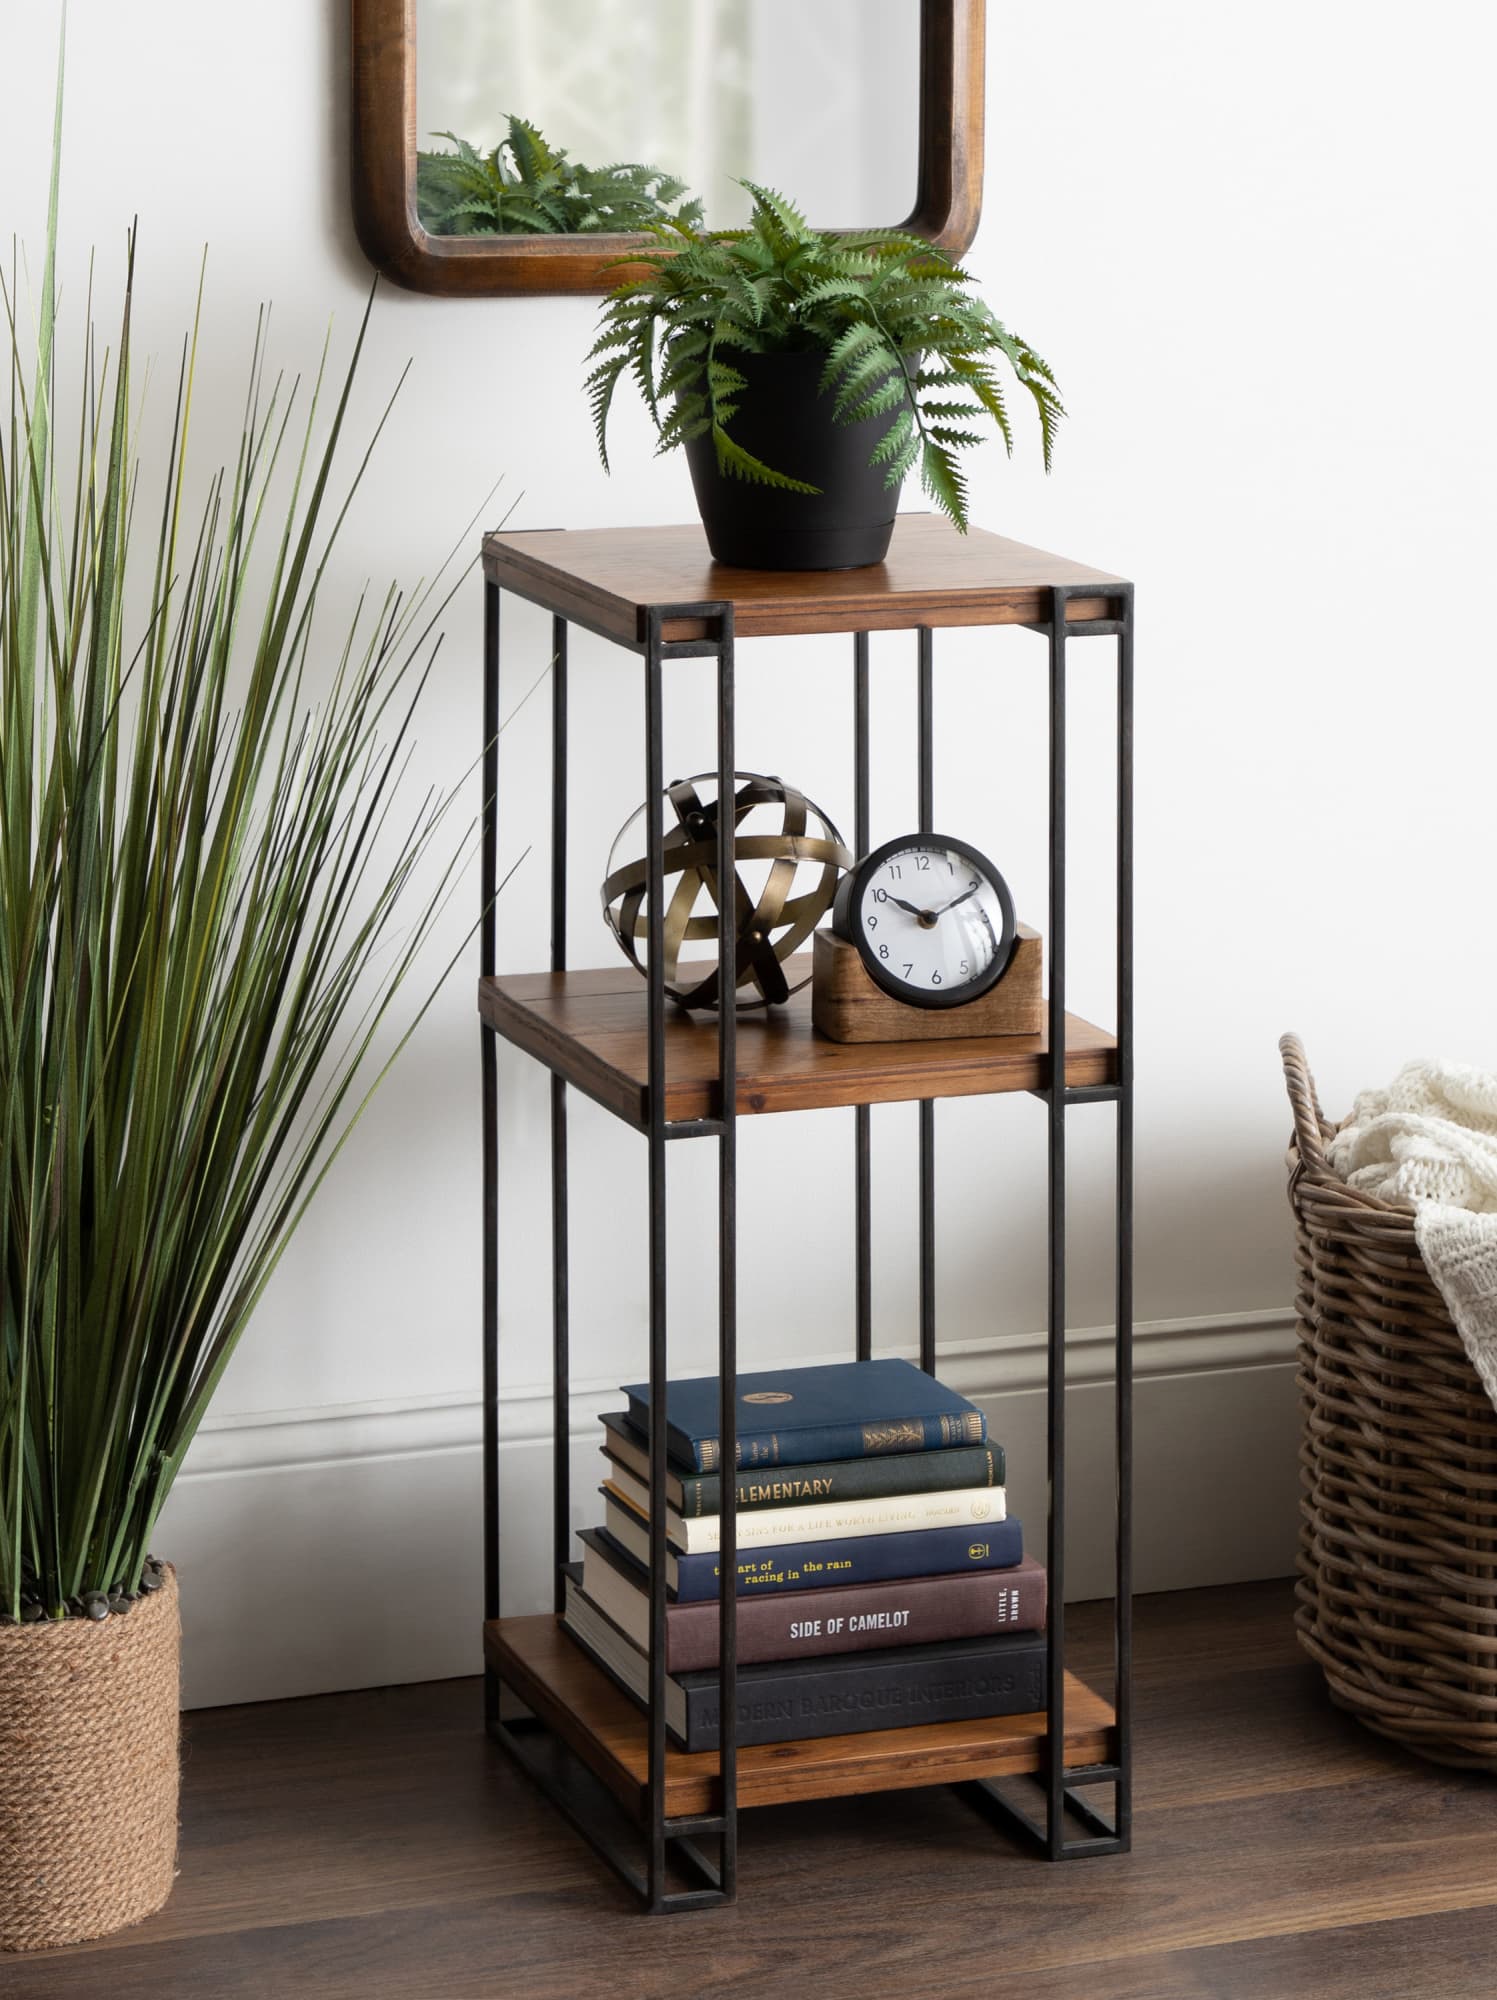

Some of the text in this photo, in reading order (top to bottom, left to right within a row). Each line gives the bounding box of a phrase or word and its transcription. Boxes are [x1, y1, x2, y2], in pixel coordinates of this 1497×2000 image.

[914, 856, 930, 871] 12
[947, 862, 954, 875] 1
[889, 865, 902, 880] 11
[872, 888, 887, 903] 10
[867, 916, 878, 931] 9
[879, 944, 889, 959] 8
[903, 964, 913, 979] 7
[960, 960, 969, 975] 5
[931, 970, 942, 985] 6
[738, 1560, 774, 1574] art of
[803, 1560, 852, 1573] the rain
[744, 1570, 800, 1584] racing in
[998, 1588, 1008, 1622] LITTLE,
[1010, 1590, 1019, 1621] BROWN
[789, 1610, 910, 1639] SIDE OF CAMELOT
[700, 1697, 792, 1728] MDERN
